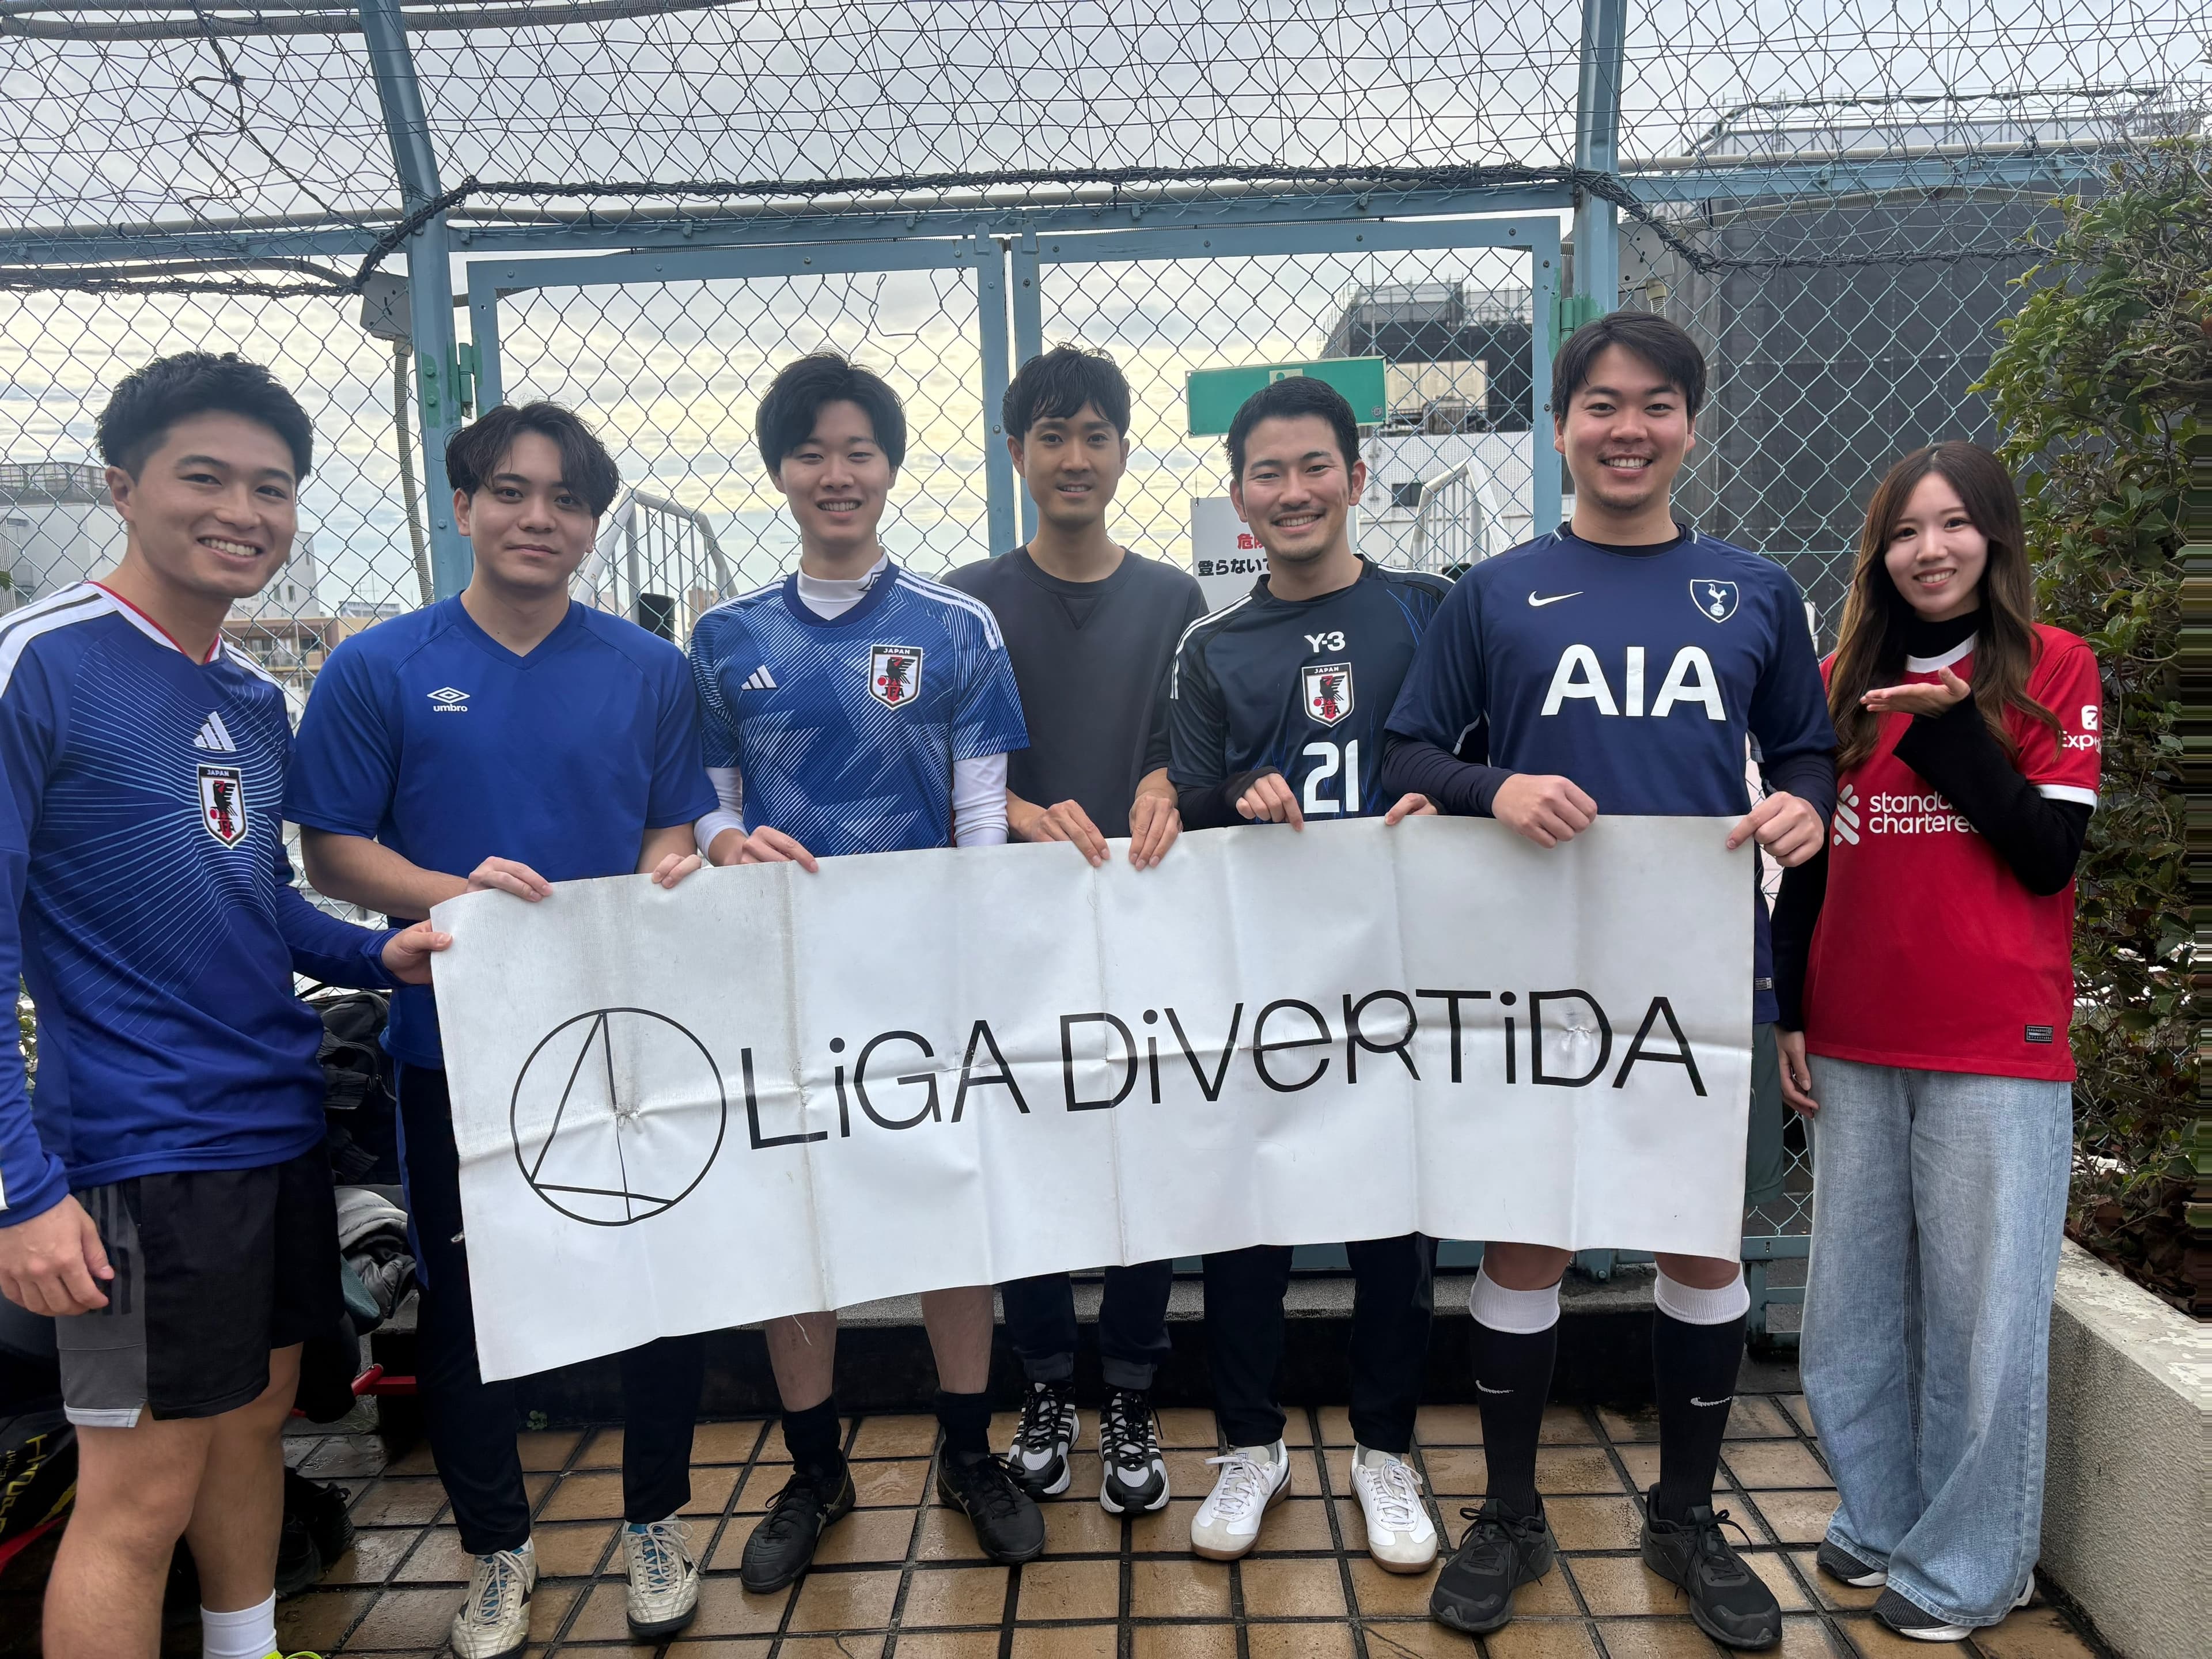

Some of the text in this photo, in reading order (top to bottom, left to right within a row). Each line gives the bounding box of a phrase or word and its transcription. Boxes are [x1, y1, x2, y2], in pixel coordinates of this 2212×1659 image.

[1237, 533, 1263, 550] 危
[1304, 631, 1346, 653] Y-3
[881, 687, 905, 698] JFA
[1540, 643, 1726, 721] AIA
[433, 703, 468, 712] umbro
[1319, 705, 1340, 715] JFA
[1302, 739, 1359, 814] 21
[1869, 791, 1957, 813] standa
[1869, 813, 1980, 834] chartere
